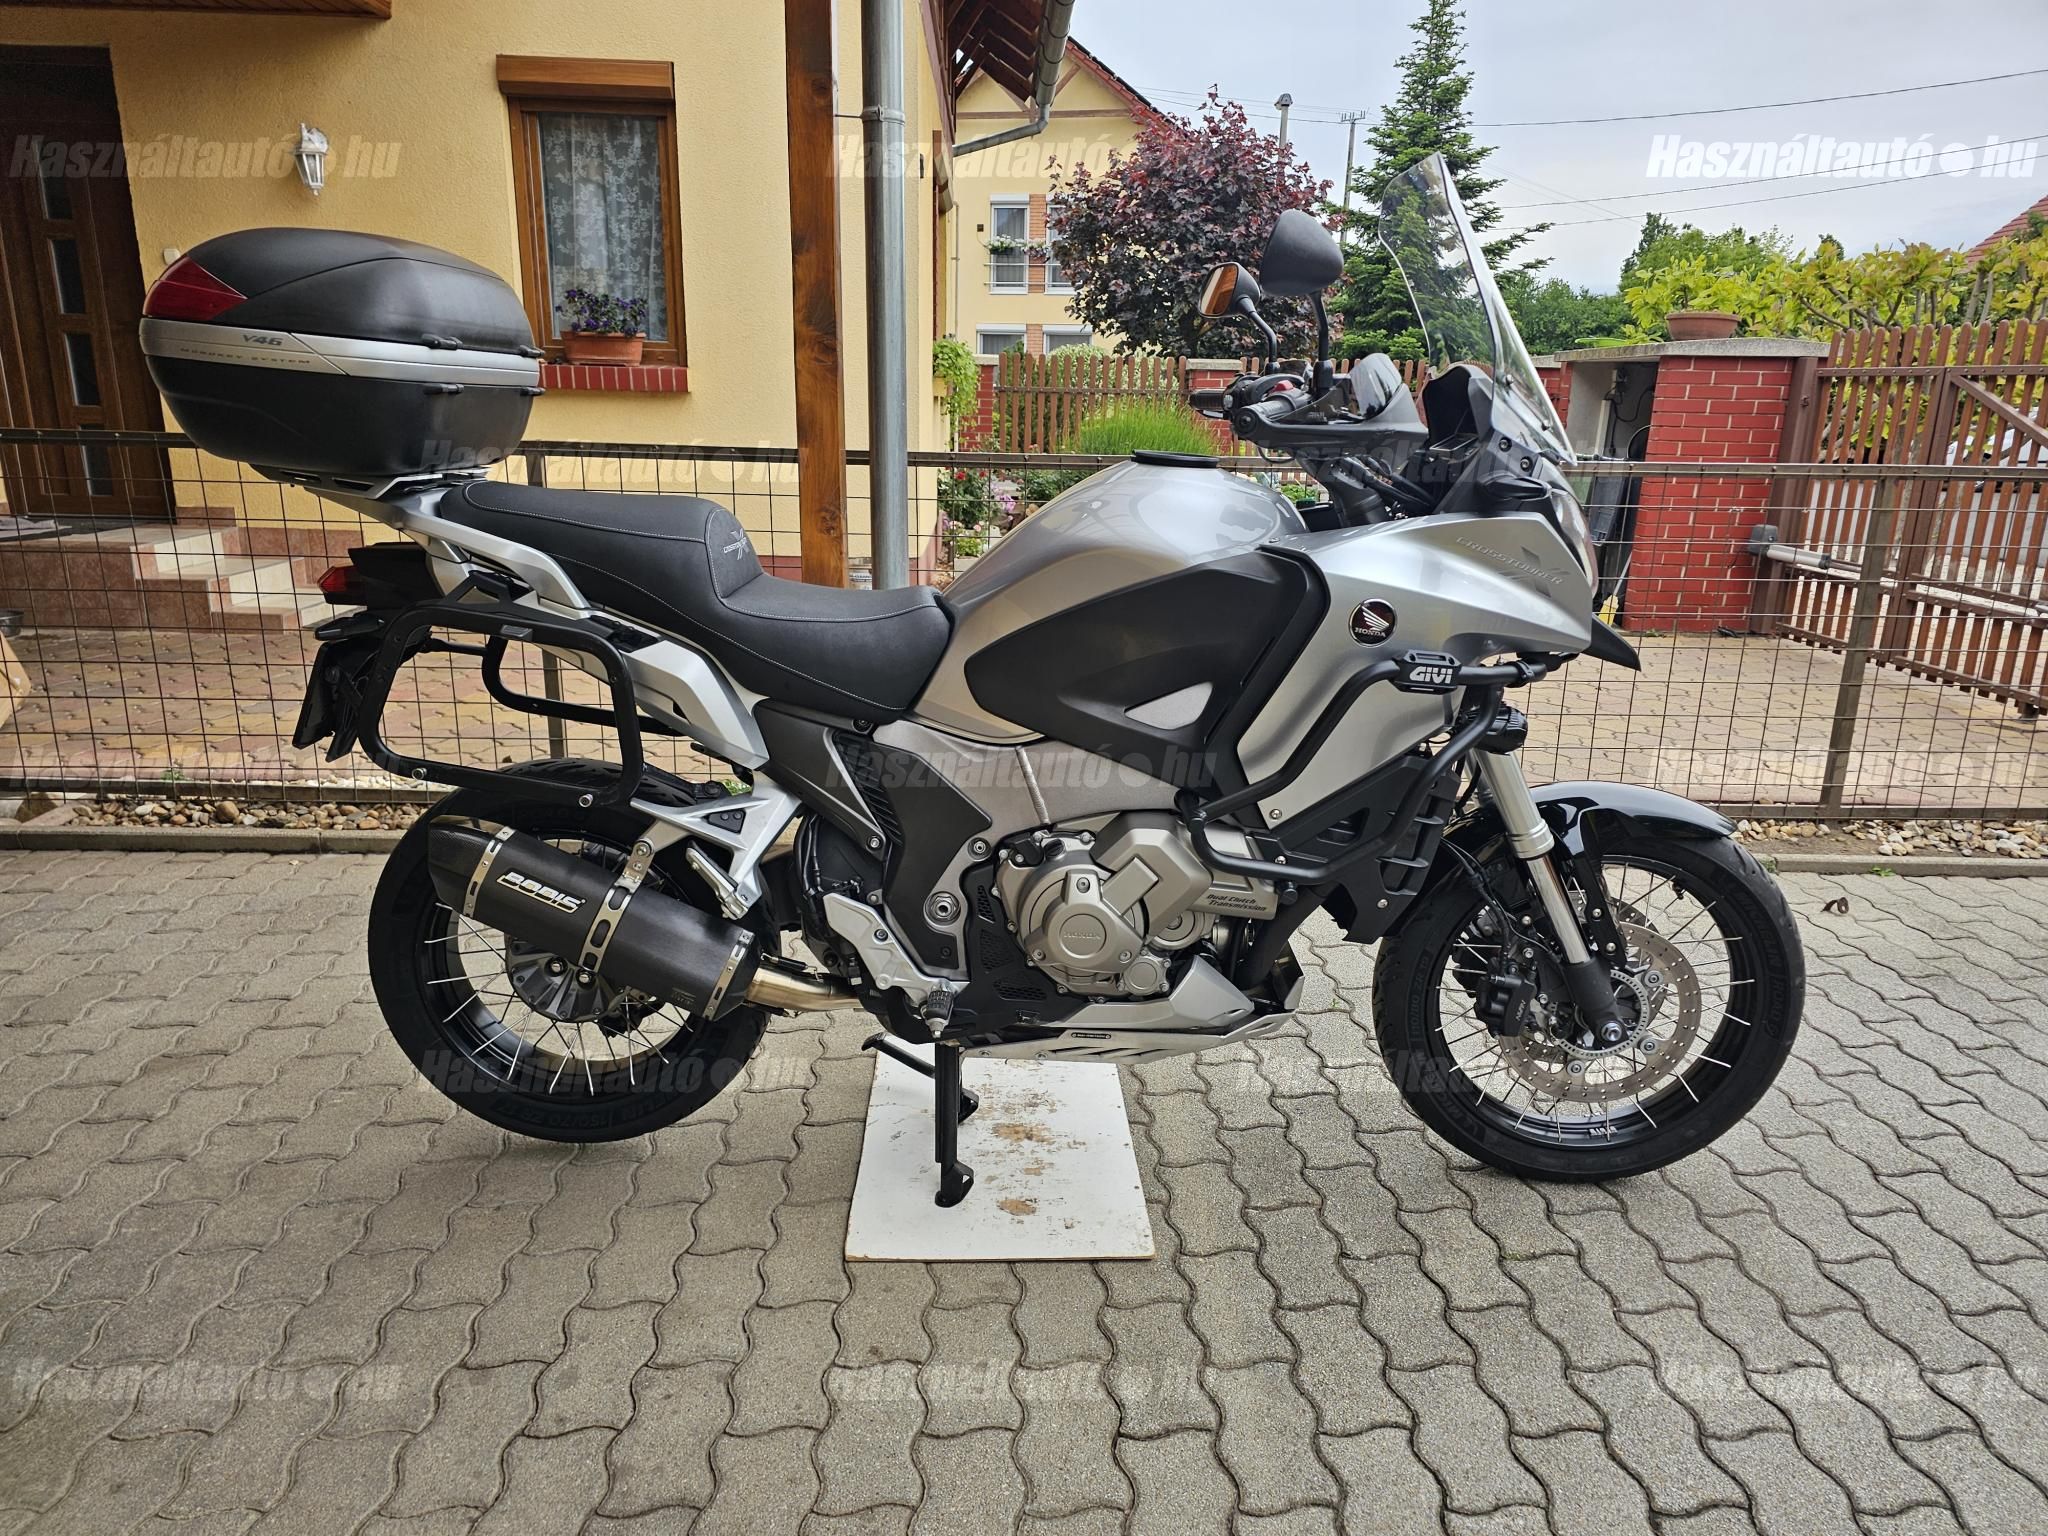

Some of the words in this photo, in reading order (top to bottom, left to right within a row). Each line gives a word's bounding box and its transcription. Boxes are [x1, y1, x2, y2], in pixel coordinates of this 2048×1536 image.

[242, 334, 285, 346] V46
[1456, 536, 1564, 585] CROSSTOURER
[1354, 627, 1387, 638] HONDA
[1409, 666, 1453, 684] GIVI
[496, 871, 586, 914] BODIS
[1208, 900, 1267, 912] Transmission
[1228, 896, 1257, 905] Clutch
